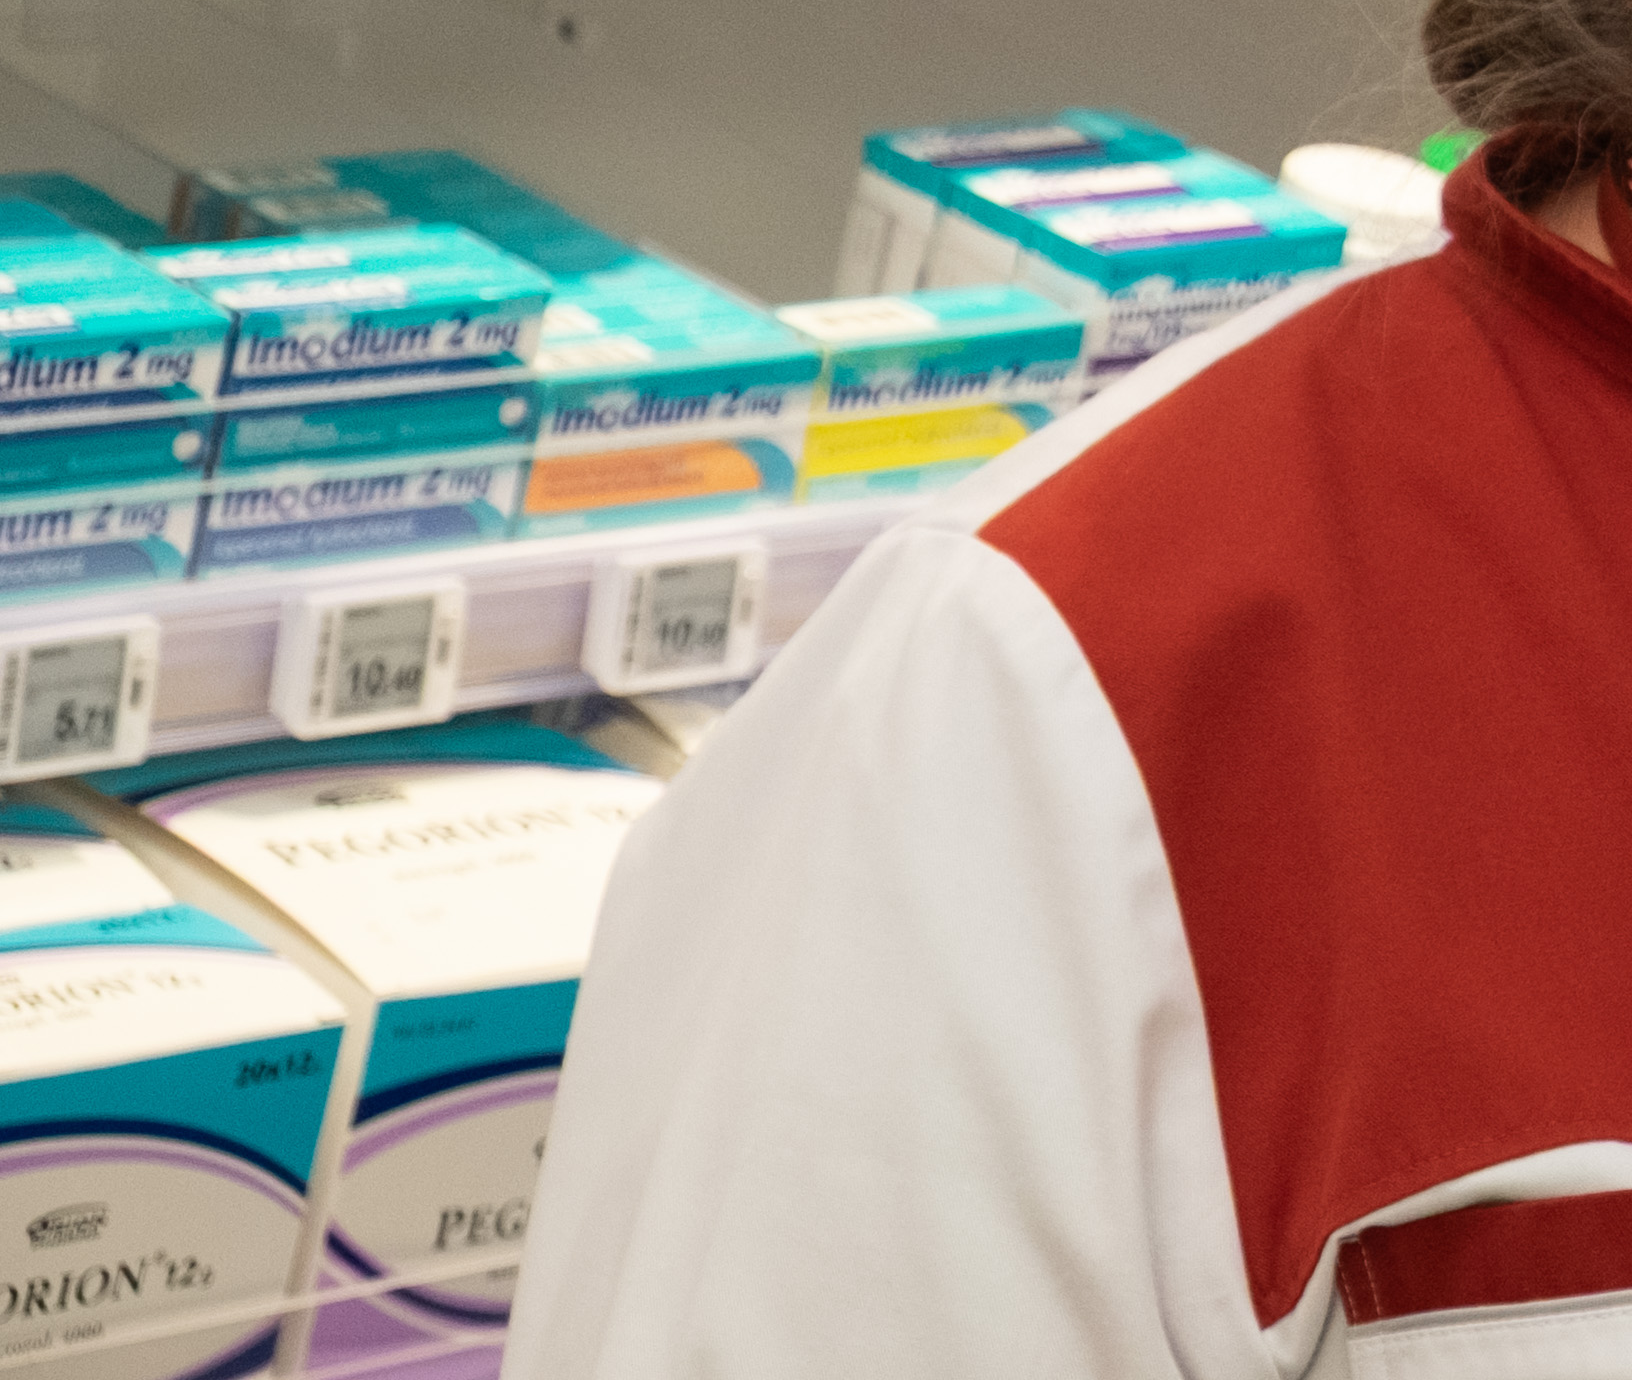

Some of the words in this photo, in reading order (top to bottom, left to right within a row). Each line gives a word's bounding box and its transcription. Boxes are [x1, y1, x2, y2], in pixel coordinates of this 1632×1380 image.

[249, 316, 433, 366] Imodium
[446, 307, 470, 348] 2
[475, 321, 520, 350] mg
[115, 340, 140, 379] 2
[147, 350, 195, 382] mg
[553, 387, 708, 435] Imodium
[828, 367, 988, 411] Imodium
